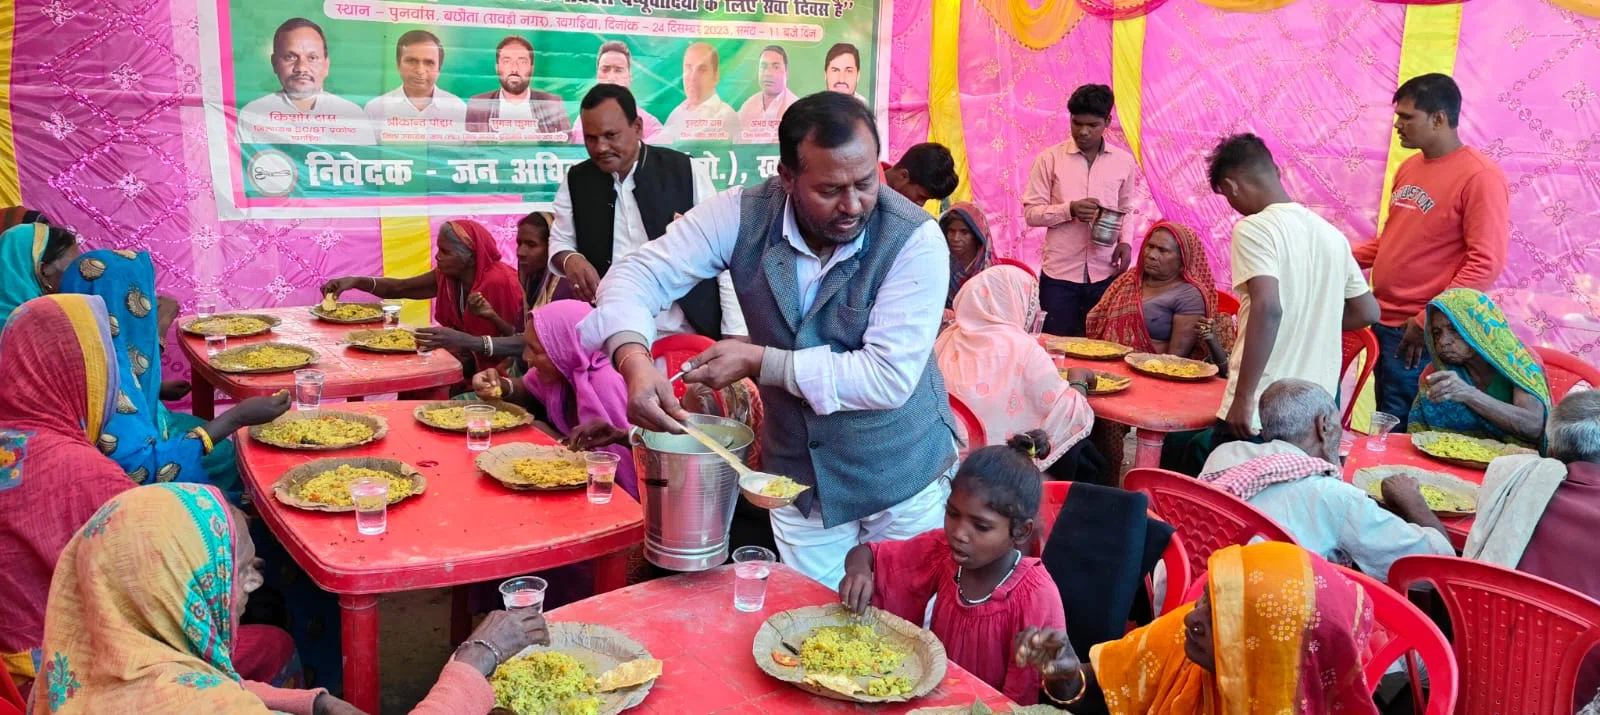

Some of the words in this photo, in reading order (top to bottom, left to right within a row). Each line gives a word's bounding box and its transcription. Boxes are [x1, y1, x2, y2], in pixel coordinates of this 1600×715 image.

[794, 0, 830, 16] दिवस
[336, 3, 371, 16] स्थान
[604, 16, 641, 31] दिनांक
[652, 22, 665, 33] 24
[314, 113, 337, 122] दास
[295, 126, 327, 134] SC/ST
[305, 151, 414, 186] निवेदक
[448, 159, 499, 185] जन
